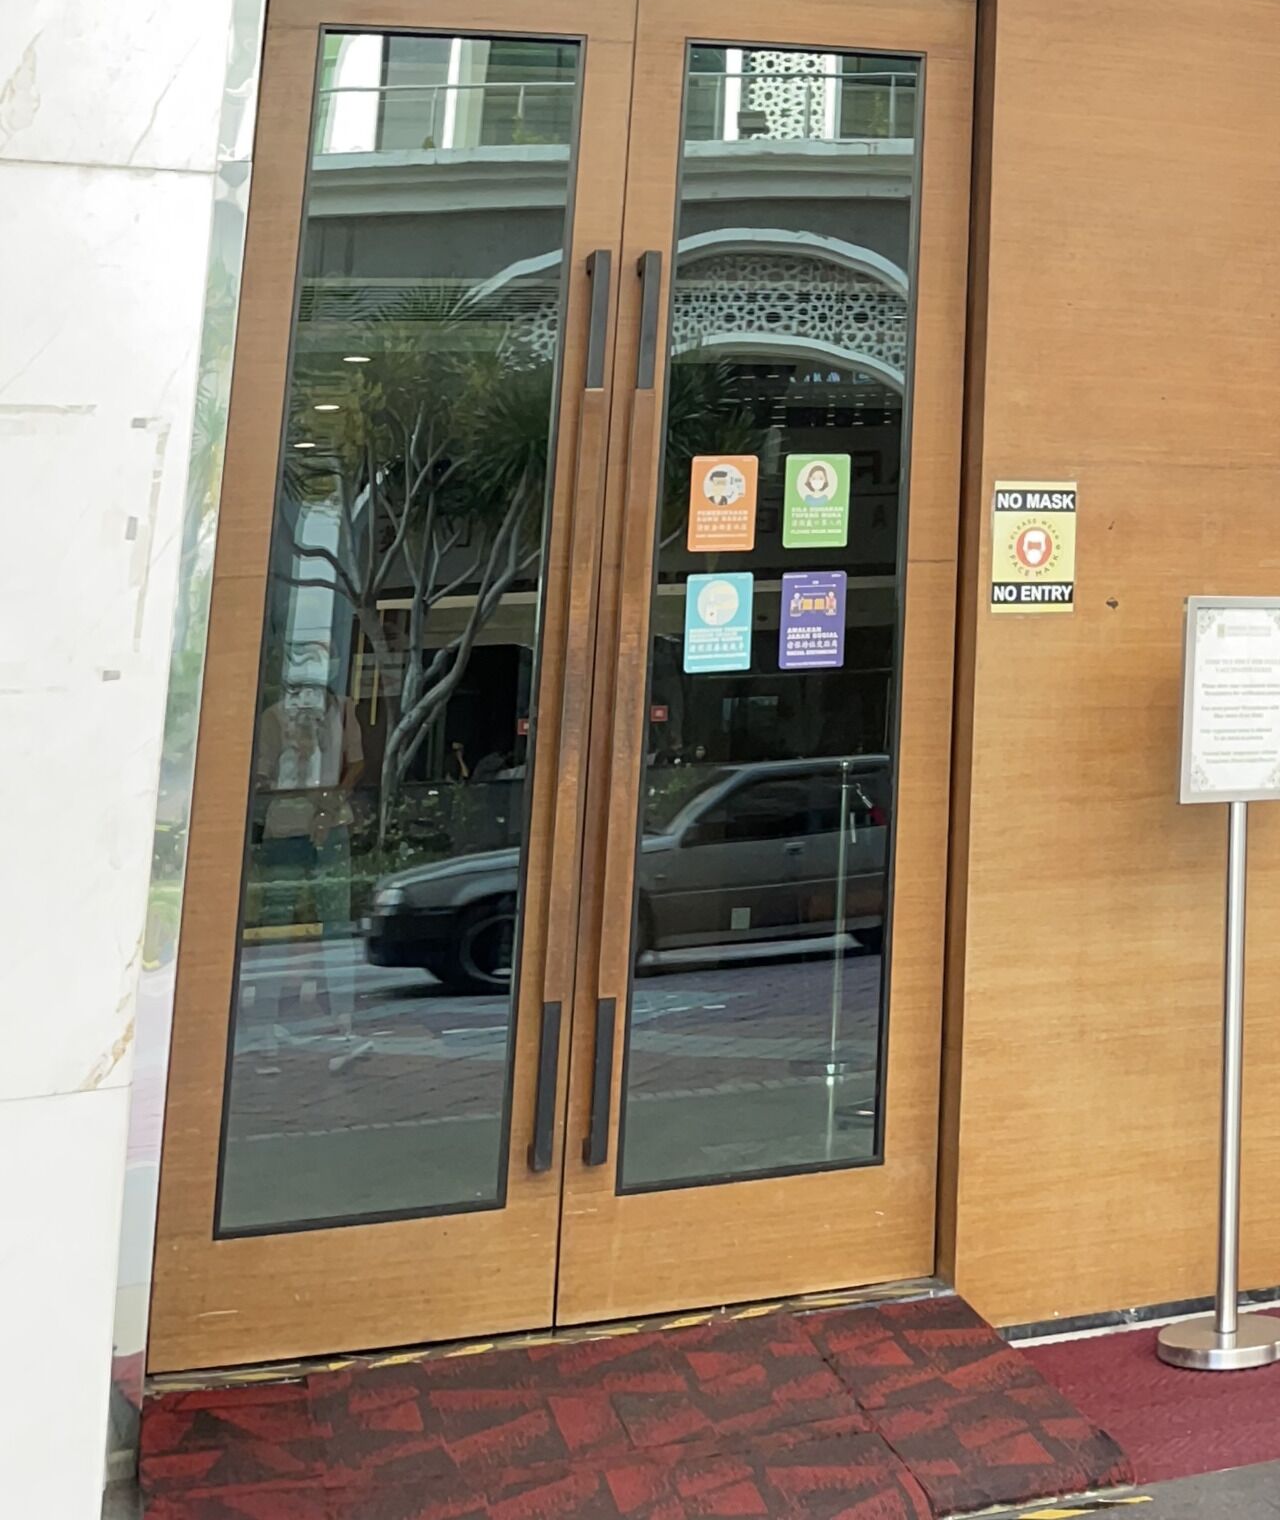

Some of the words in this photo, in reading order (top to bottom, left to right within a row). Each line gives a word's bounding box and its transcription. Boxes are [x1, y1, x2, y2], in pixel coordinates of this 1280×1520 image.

[998, 493, 1022, 509] NO
[1027, 493, 1074, 509] MASK
[994, 586, 1017, 601] NO
[1021, 585, 1072, 601] ENTRY
